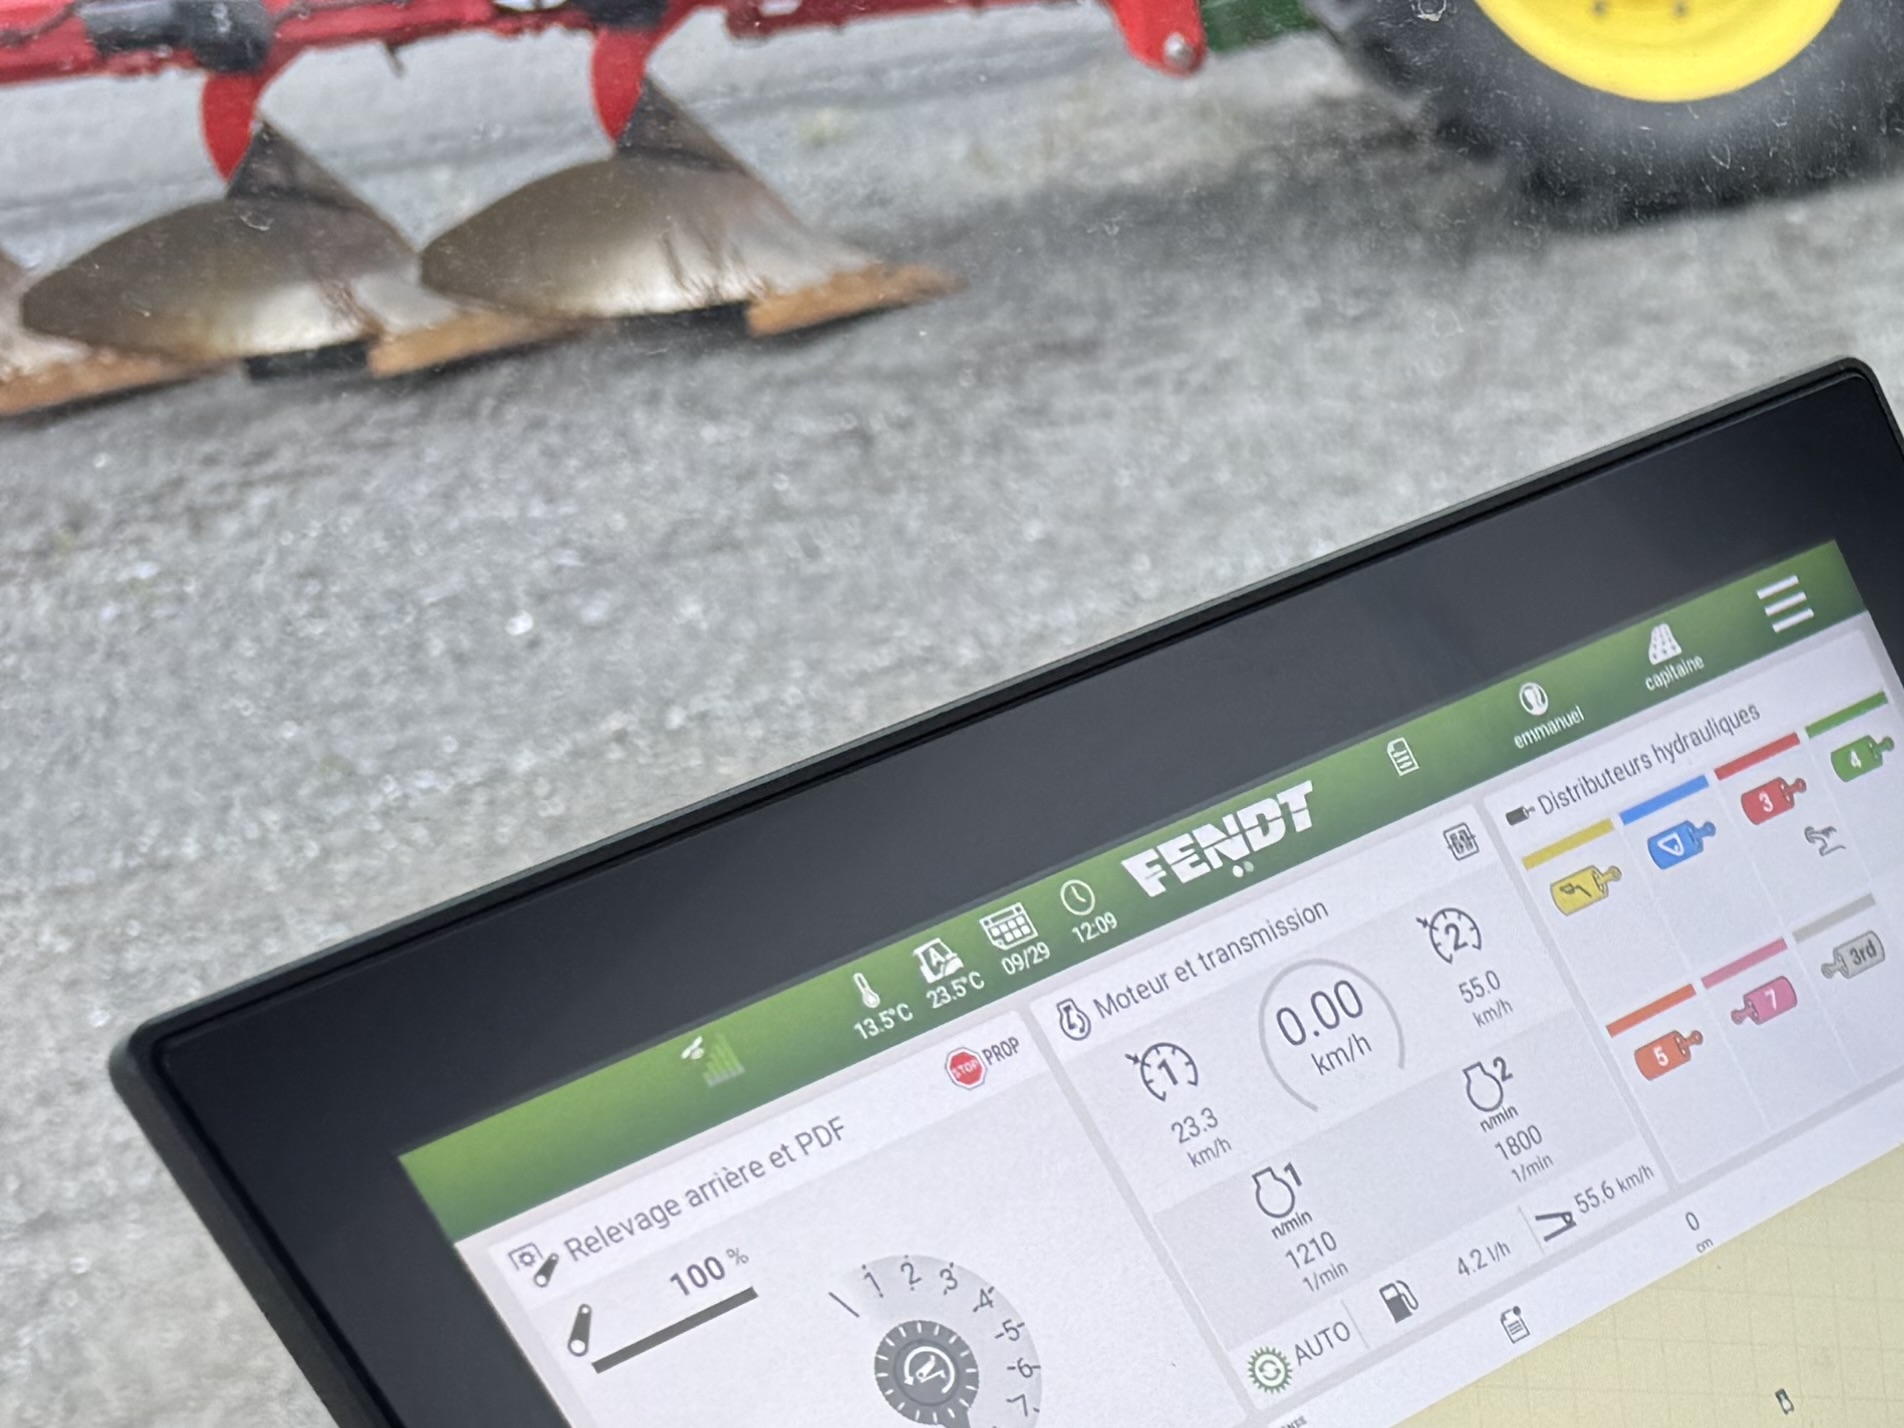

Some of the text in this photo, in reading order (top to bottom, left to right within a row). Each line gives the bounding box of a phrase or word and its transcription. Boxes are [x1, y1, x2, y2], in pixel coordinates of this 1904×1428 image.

[1645, 655, 1704, 691] capitaine
[1514, 705, 1584, 749] emmanuel
[1537, 703, 1762, 816] Distributeurs hydrauliques
[1850, 750, 1862, 768] 4
[1759, 792, 1774, 813] 3
[1121, 780, 1312, 898] FENDT
[1072, 912, 1118, 943] 12:09
[1444, 922, 1468, 951] 2
[1001, 941, 1051, 976] 09/29
[1092, 902, 1329, 1019] Moteur et transmission
[1849, 938, 1877, 966] 3rd
[926, 971, 985, 1010] 23.5°C
[1458, 970, 1501, 1004] 55.0
[1764, 990, 1779, 1011] 7
[853, 1003, 914, 1040] 13.5°C
[1276, 980, 1364, 1046] 0.00
[1472, 998, 1514, 1028] km/h
[982, 1036, 1020, 1065] PROP
[1311, 1031, 1373, 1076] km/h
[1654, 1046, 1669, 1067] 5
[951, 1059, 981, 1080] STOP
[1158, 1059, 1178, 1086] 1
[1493, 1056, 1514, 1082] 2
[1171, 1107, 1219, 1143] 23.3
[1480, 1105, 1519, 1133] n/min
[1187, 1137, 1232, 1168] km/h
[1494, 1124, 1543, 1161] 1800
[1284, 1161, 1302, 1187] 1
[1511, 1154, 1555, 1183] 1/min
[564, 1116, 846, 1262] Relevage arrière et PDF
[1574, 1165, 1655, 1214] 55.6 km/h
[1271, 1210, 1313, 1239] n/min
[1684, 1211, 1700, 1232] 0
[1285, 1231, 1338, 1270] 1210
[1696, 1238, 1714, 1254] cm
[670, 1248, 750, 1297] 100 %
[900, 1262, 922, 1286] 2
[1302, 1262, 1349, 1292] 1/min
[1456, 1248, 1488, 1277] 4.2
[864, 1270, 882, 1296] 1
[939, 1268, 959, 1291] 3
[976, 1288, 994, 1310] 4
[1002, 1318, 1021, 1342] 5
[1294, 1321, 1350, 1366] AUTO
[1016, 1358, 1035, 1379] 6
[1006, 1394, 1028, 1417] 7
